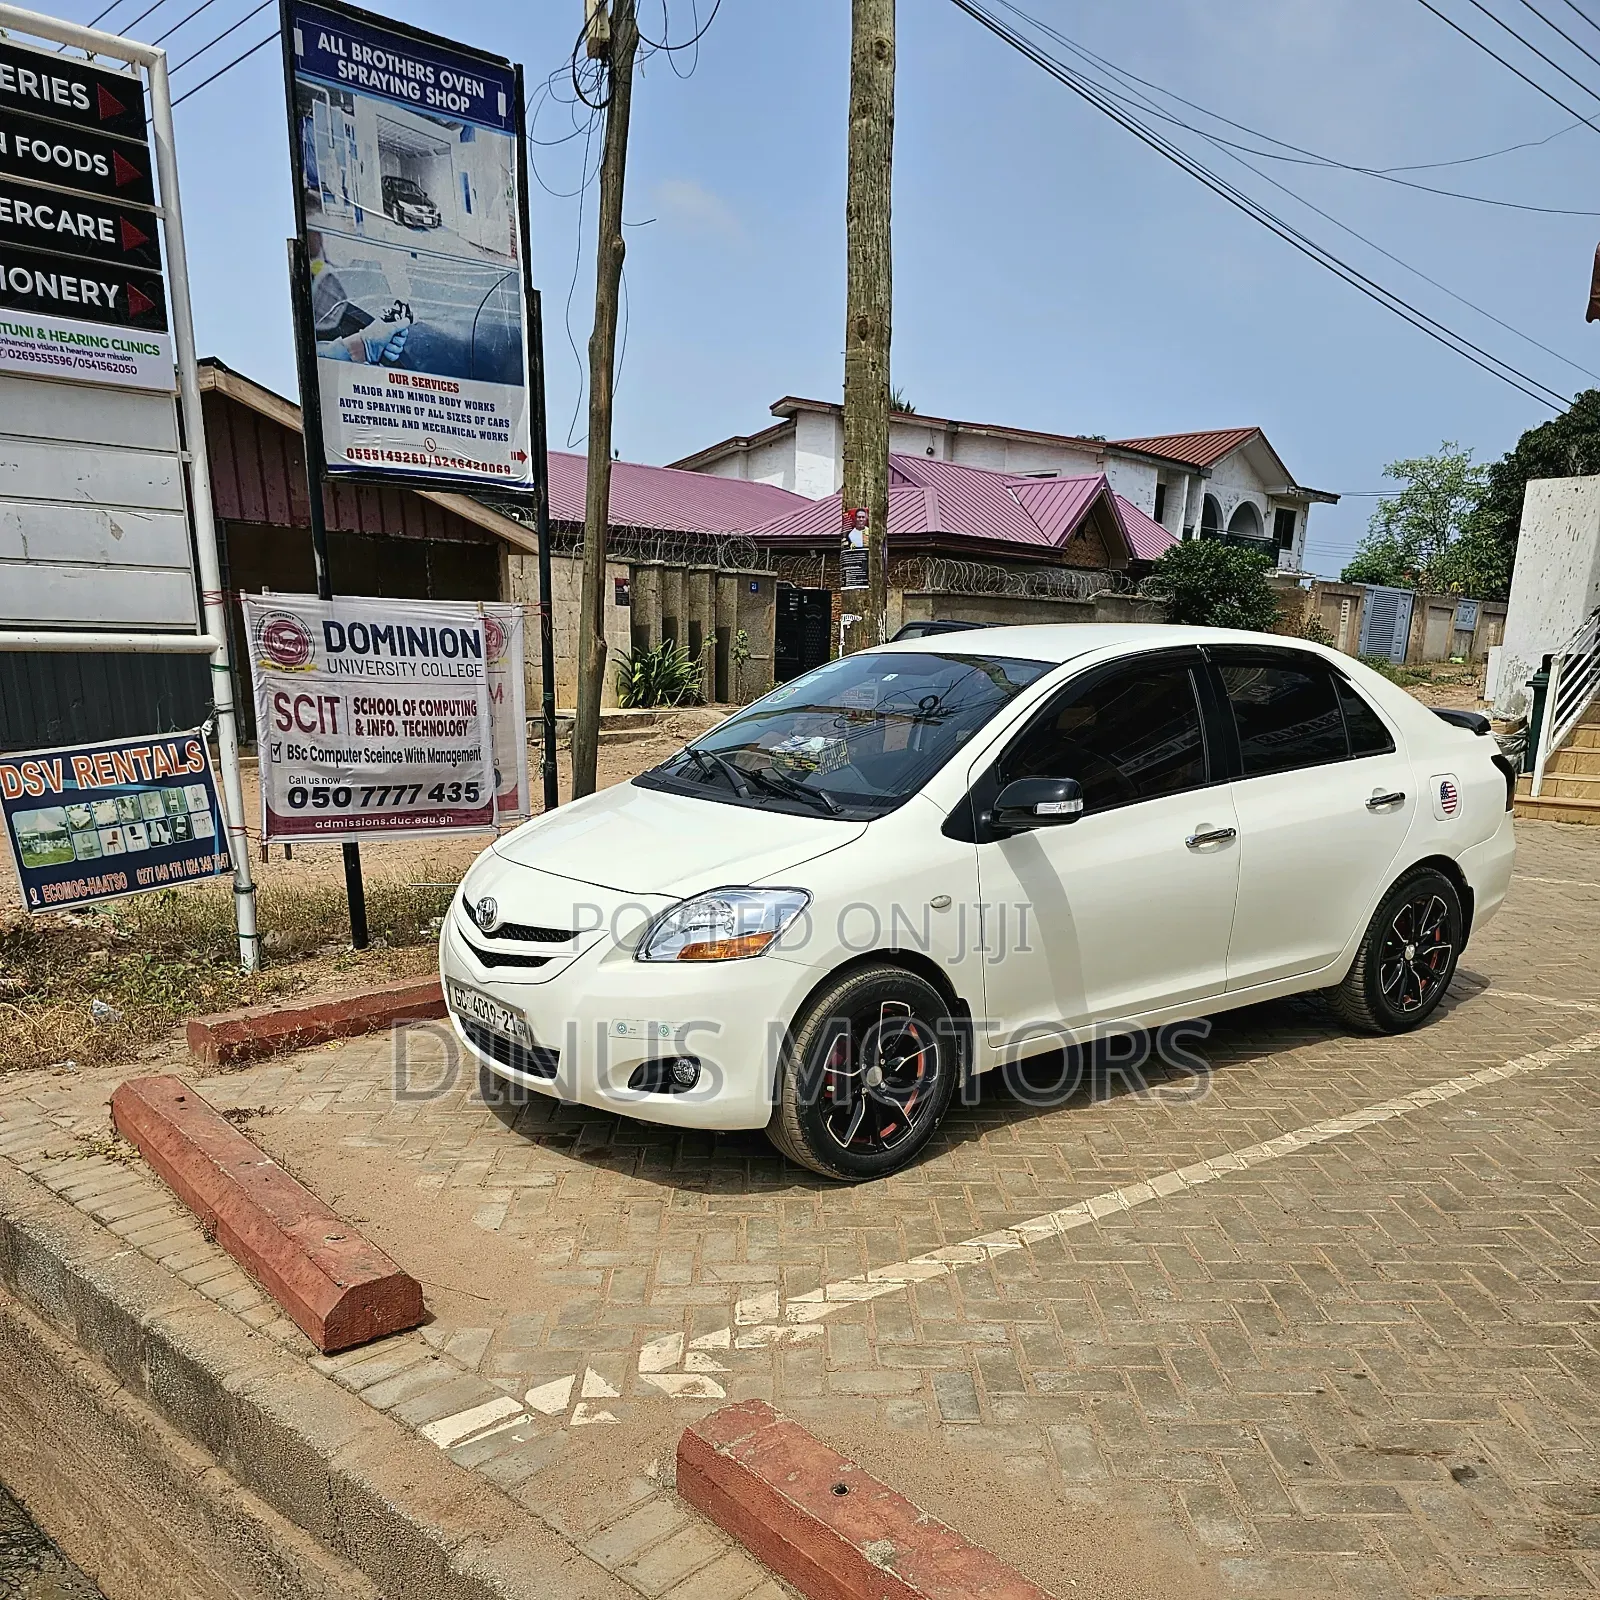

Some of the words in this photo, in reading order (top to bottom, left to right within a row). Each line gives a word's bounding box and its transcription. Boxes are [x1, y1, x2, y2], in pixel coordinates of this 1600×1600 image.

[317, 32, 347, 57] ALL
[351, 42, 435, 84] BROTHERS
[439, 72, 485, 99] OVEN
[0, 64, 90, 110] ERIES
[337, 60, 421, 100] SPRAYING
[425, 87, 470, 113] SHOP
[15, 135, 109, 176] FOODS
[0, 197, 116, 243] ERCARE
[0, 265, 120, 309] IONERY
[0, 322, 33, 339] TUNI
[37, 328, 47, 340] &
[49, 330, 109, 349] HEARING
[111, 339, 160, 356] CLINICS
[0, 337, 36, 350] nhancing
[37, 343, 58, 352] vision
[66, 346, 93, 358] hearing
[107, 352, 133, 362] mission
[353, 384, 383, 398] MAJOR
[386, 388, 404, 400] AND
[407, 390, 437, 404] MINOR
[439, 396, 462, 409] BODY
[464, 399, 496, 413] WORKS
[388, 372, 409, 386] OUR
[411, 376, 460, 394] SERVICES
[340, 398, 364, 410] AUTO
[367, 401, 412, 415] SPRAYING
[414, 406, 425, 417] OF
[427, 408, 445, 420] ALL
[446, 411, 472, 425] SIZES
[474, 416, 486, 426] OF
[487, 417, 510, 429] CARS
[342, 413, 399, 428] ELECTRICAL
[401, 419, 420, 430] AND
[422, 421, 477, 439] MECHANICAL
[479, 429, 509, 442] WORKS
[322, 620, 483, 659] DOMINION
[327, 658, 417, 677] UNIVERSITY
[422, 662, 484, 678] COLLEGE
[274, 691, 341, 735] SCIT
[353, 697, 401, 716] SCHOOL
[402, 699, 417, 716] OF
[418, 699, 477, 717] COMPUTING
[355, 719, 365, 736] &
[367, 719, 398, 737] INFO.
[402, 720, 468, 737] TECHNOLOGY
[0, 757, 63, 800] DSV
[70, 739, 205, 790] RENTALS
[287, 744, 308, 761] BSc
[309, 746, 363, 768] Computer
[364, 746, 403, 764] Sceince
[404, 748, 426, 764] With
[427, 746, 482, 768] Management
[287, 786, 352, 809] 050
[360, 783, 424, 808] 7777
[427, 781, 480, 803] 435
[288, 775, 306, 785] Call
[308, 777, 320, 785] us
[321, 777, 341, 785] now
[315, 814, 454, 829] admissions.duc.edu.gh
[454, 986, 468, 1011] GC
[473, 995, 517, 1036] 4019-21
